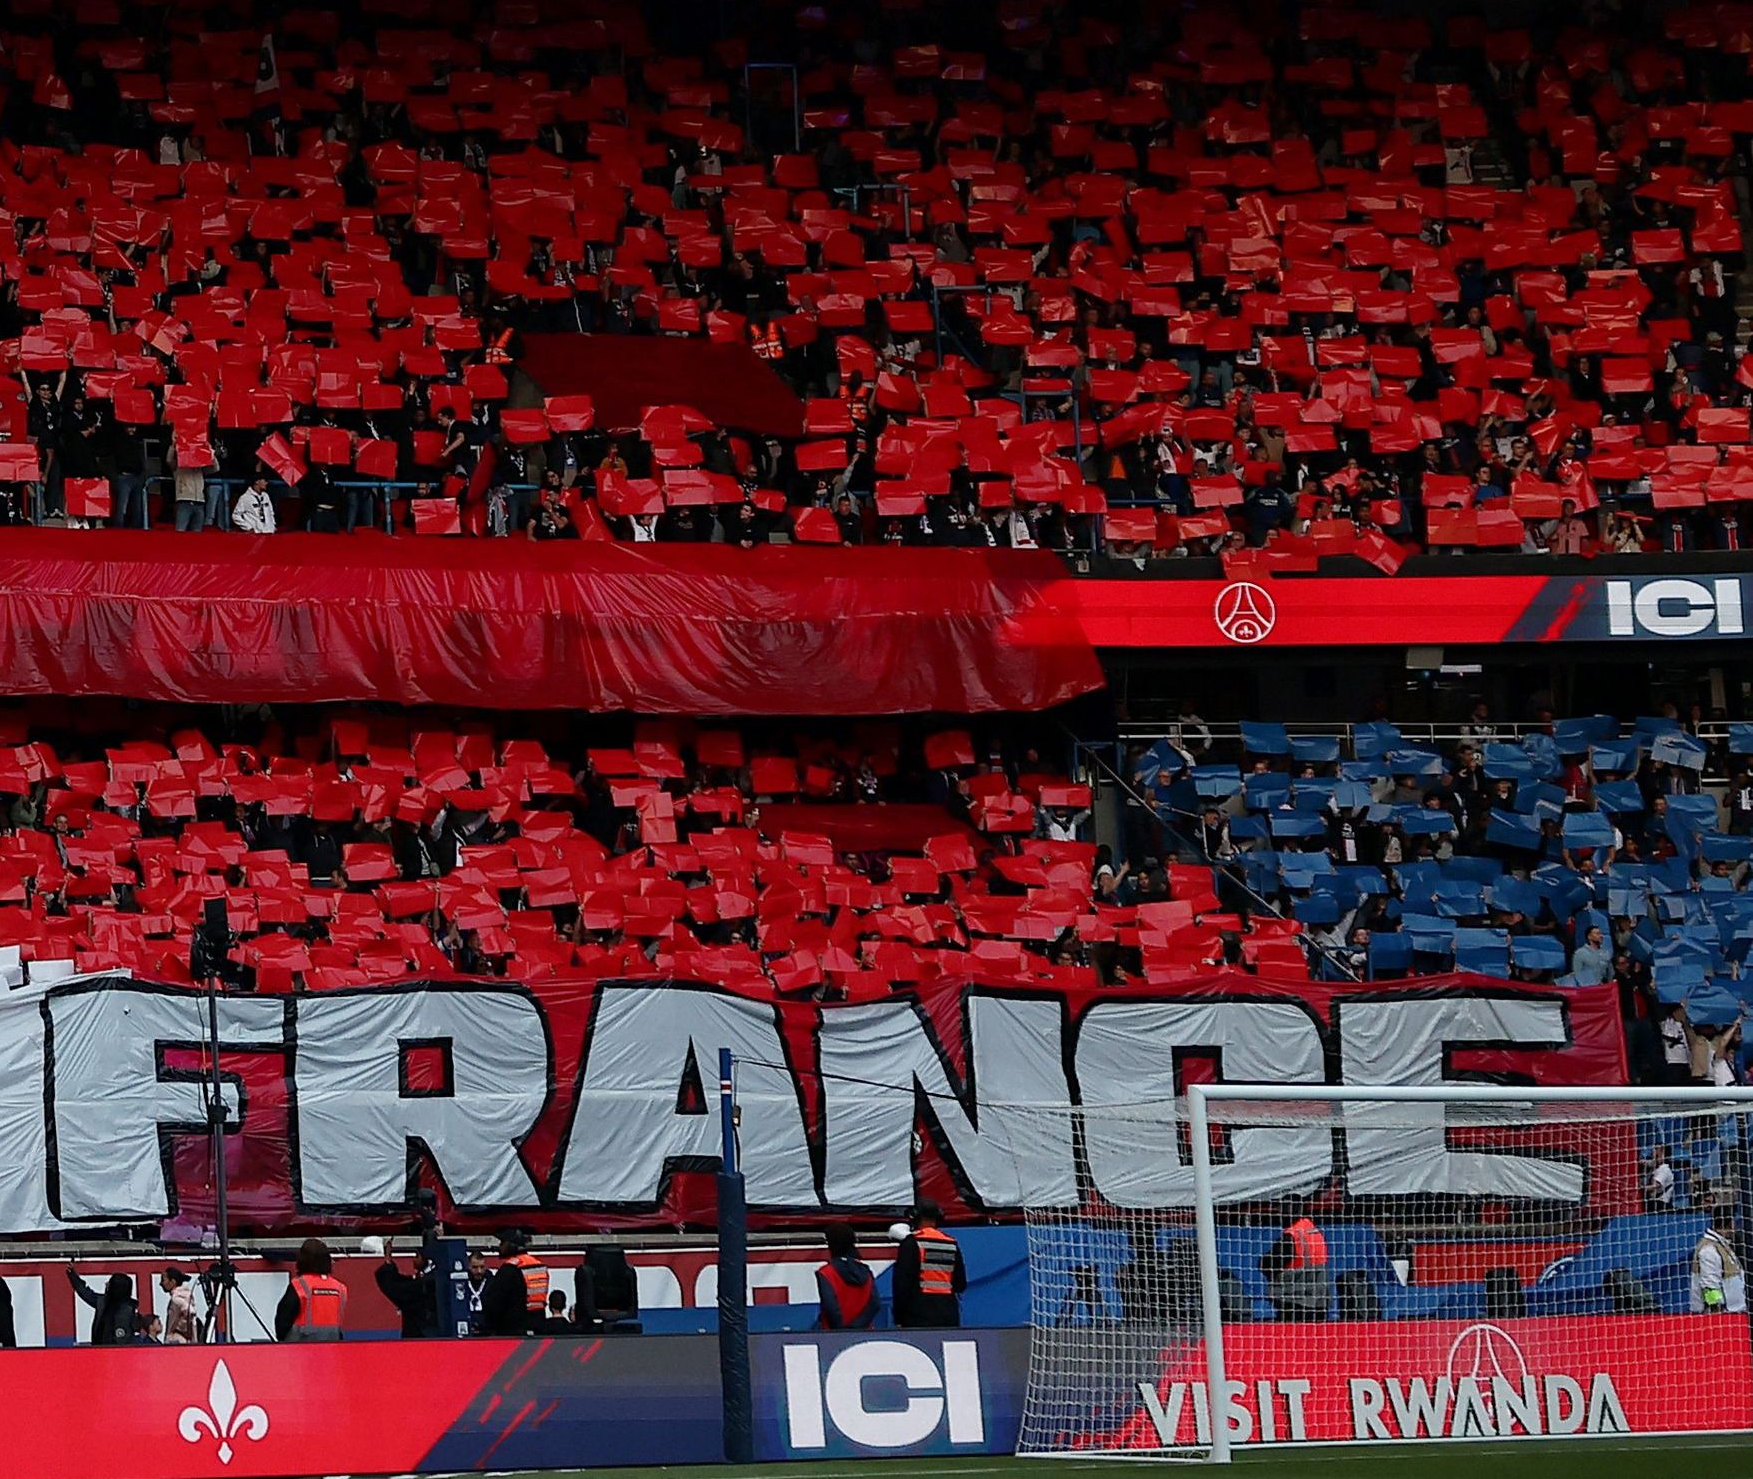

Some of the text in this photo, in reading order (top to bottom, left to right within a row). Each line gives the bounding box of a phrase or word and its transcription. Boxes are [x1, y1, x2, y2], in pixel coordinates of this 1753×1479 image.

[1606, 577, 1744, 636] ICI
[41, 977, 1586, 1222] FRANCE
[782, 1340, 986, 1450] ICI
[1138, 1372, 1631, 1447] VISIT RWANDA
